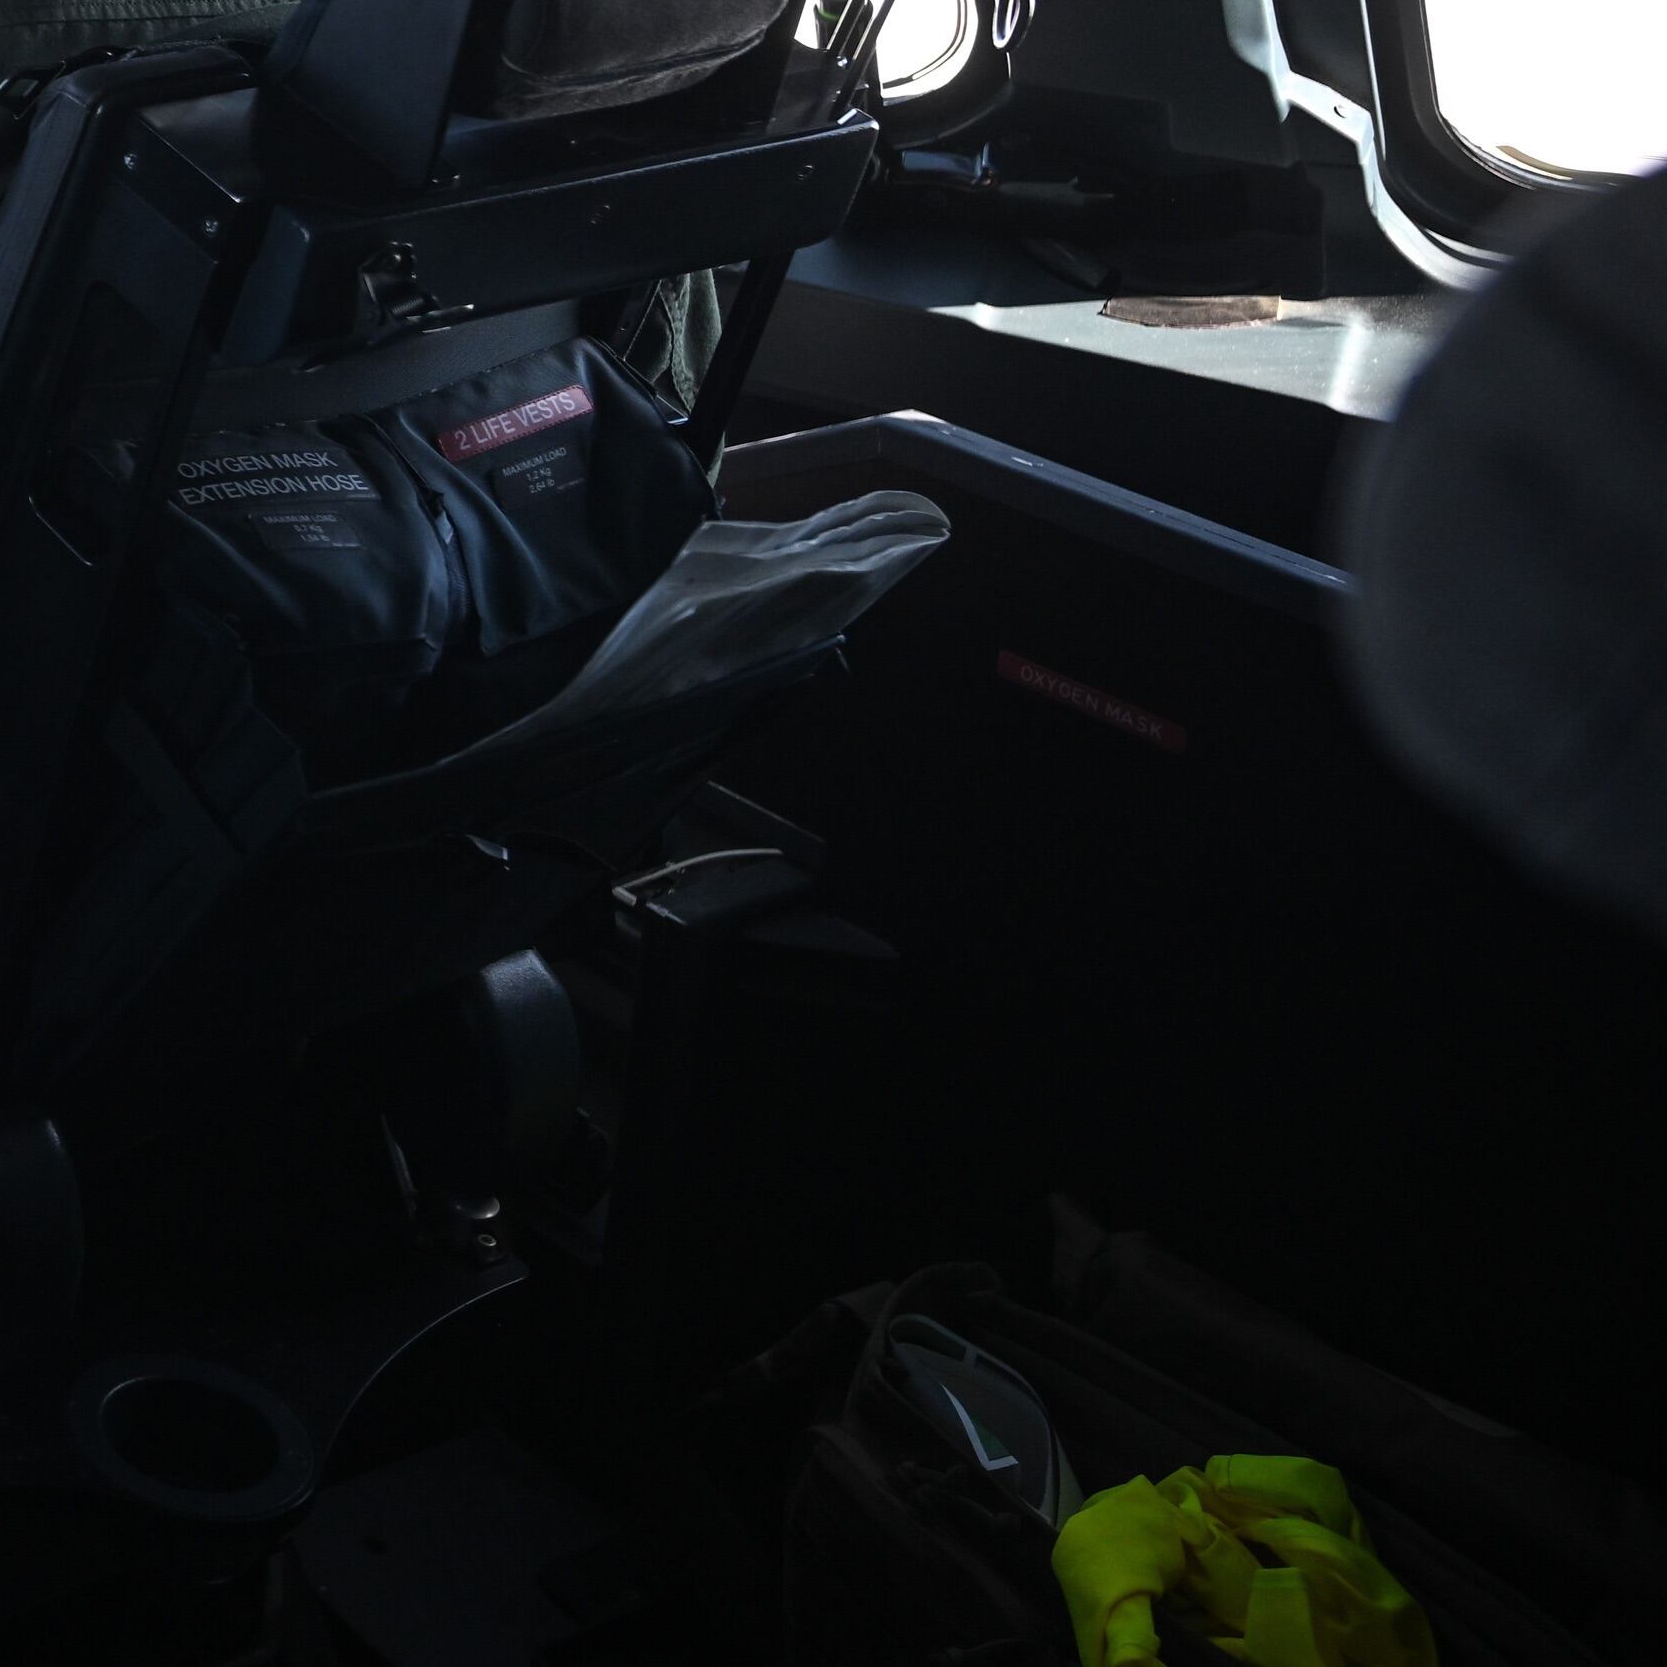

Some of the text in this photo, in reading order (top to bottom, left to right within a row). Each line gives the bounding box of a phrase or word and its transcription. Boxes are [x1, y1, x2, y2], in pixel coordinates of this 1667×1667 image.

[454, 391, 576, 451] 2 LIFE VESTS
[177, 450, 337, 479] OXYGEN MASK
[502, 447, 567, 479] MAXIMUM LOAD
[178, 474, 368, 506] EXTENSION HOSE
[1019, 663, 1164, 741] OXYGEN MASK
